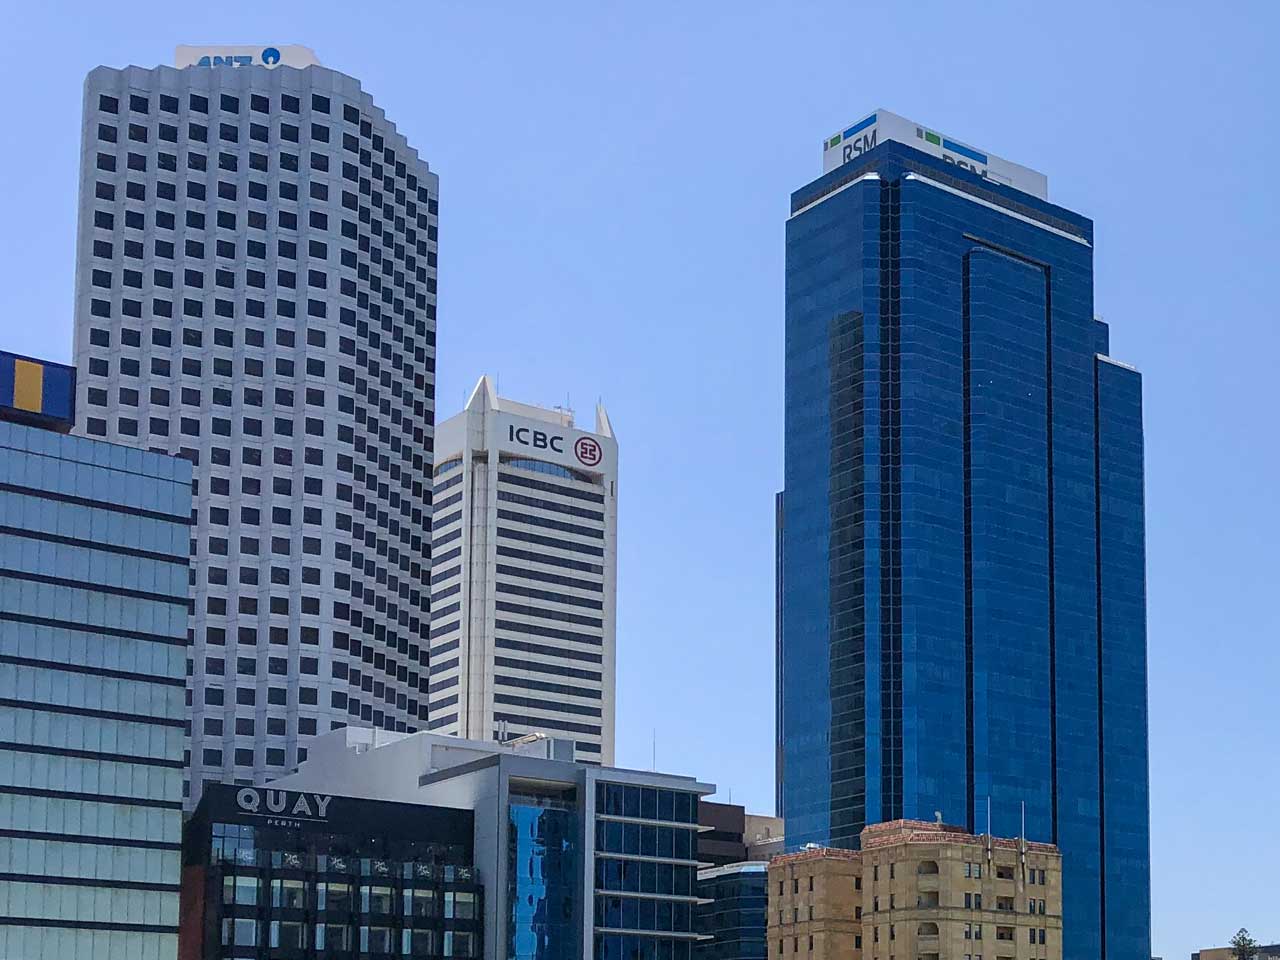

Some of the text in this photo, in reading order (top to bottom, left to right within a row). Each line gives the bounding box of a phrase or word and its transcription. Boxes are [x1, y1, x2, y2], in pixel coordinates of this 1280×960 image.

[842, 129, 877, 164] RSM
[508, 424, 564, 454] ICBC
[236, 787, 333, 817] QUAY
[267, 818, 301, 829] PERTH
